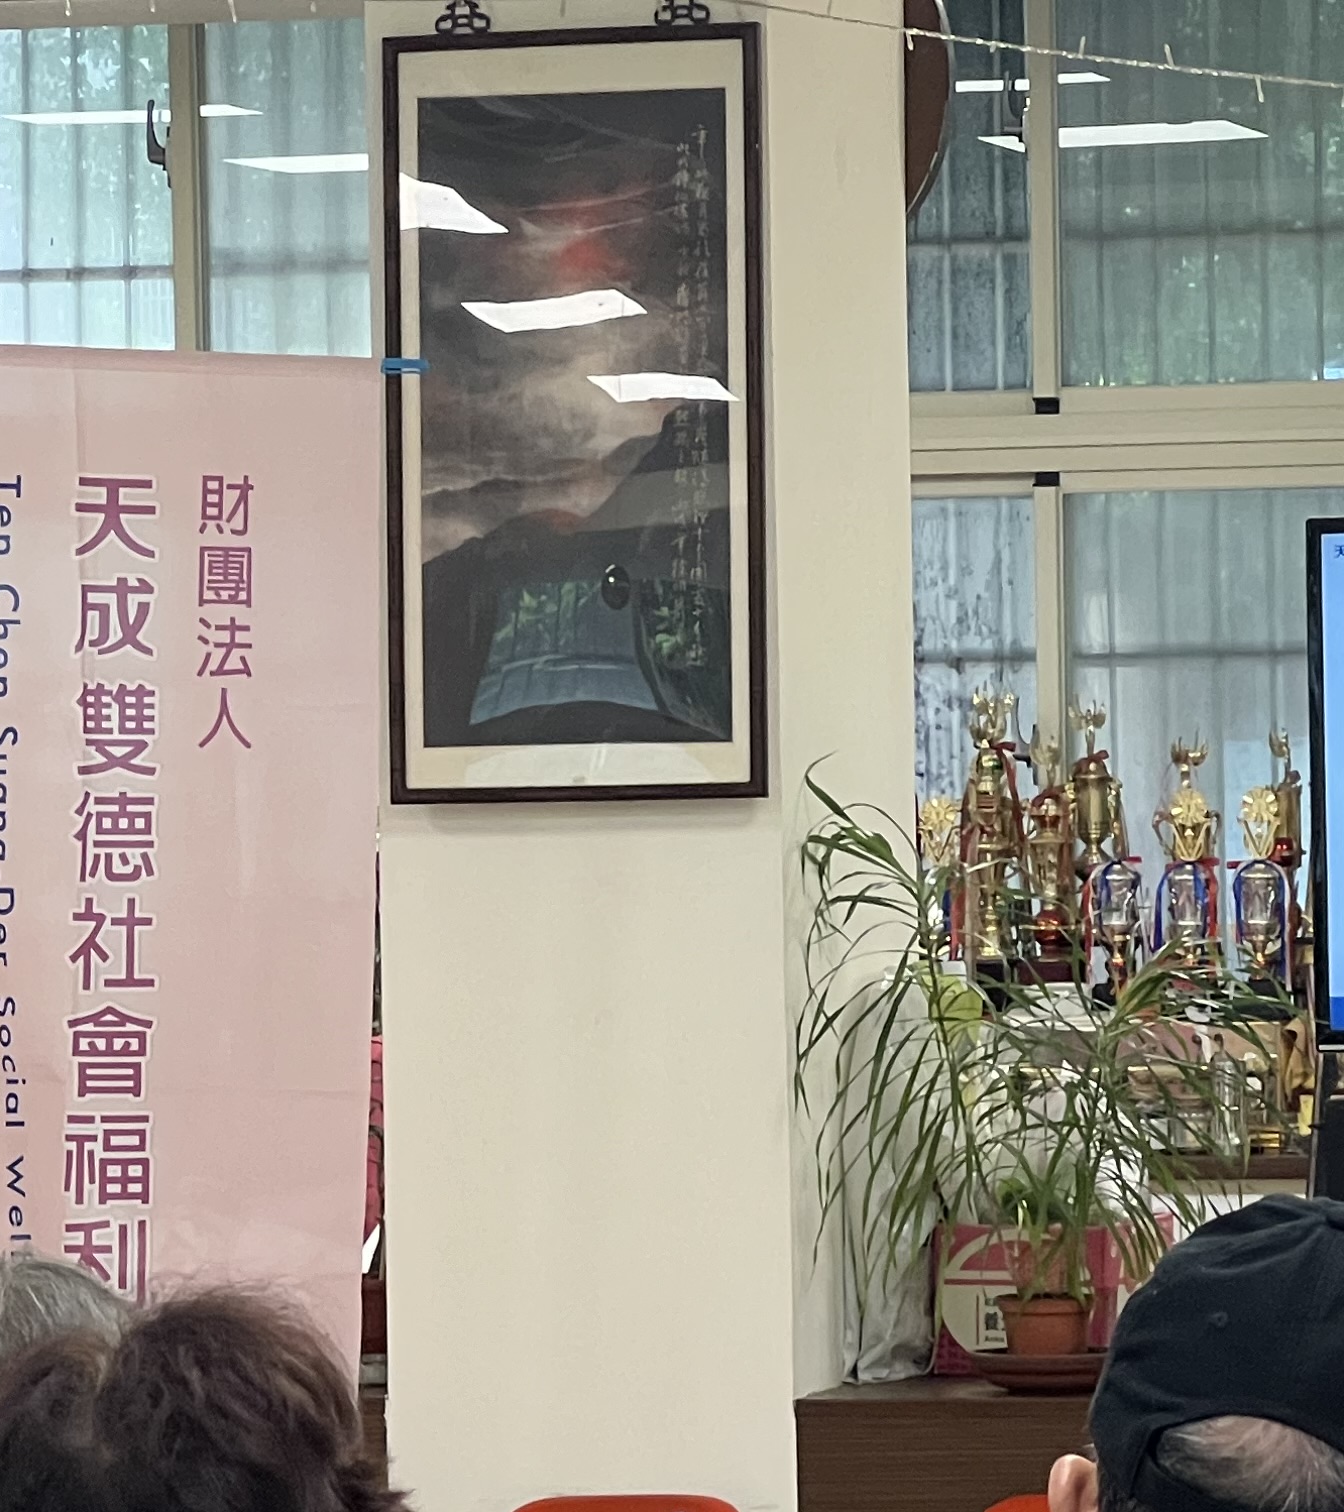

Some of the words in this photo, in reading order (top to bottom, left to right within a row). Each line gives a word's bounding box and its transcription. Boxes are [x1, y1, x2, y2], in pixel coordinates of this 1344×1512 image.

[197, 474, 255, 750] 財團法人
[63, 476, 159, 1308] 天成雙德社會福利
[6, 1155, 32, 1257] Wel
